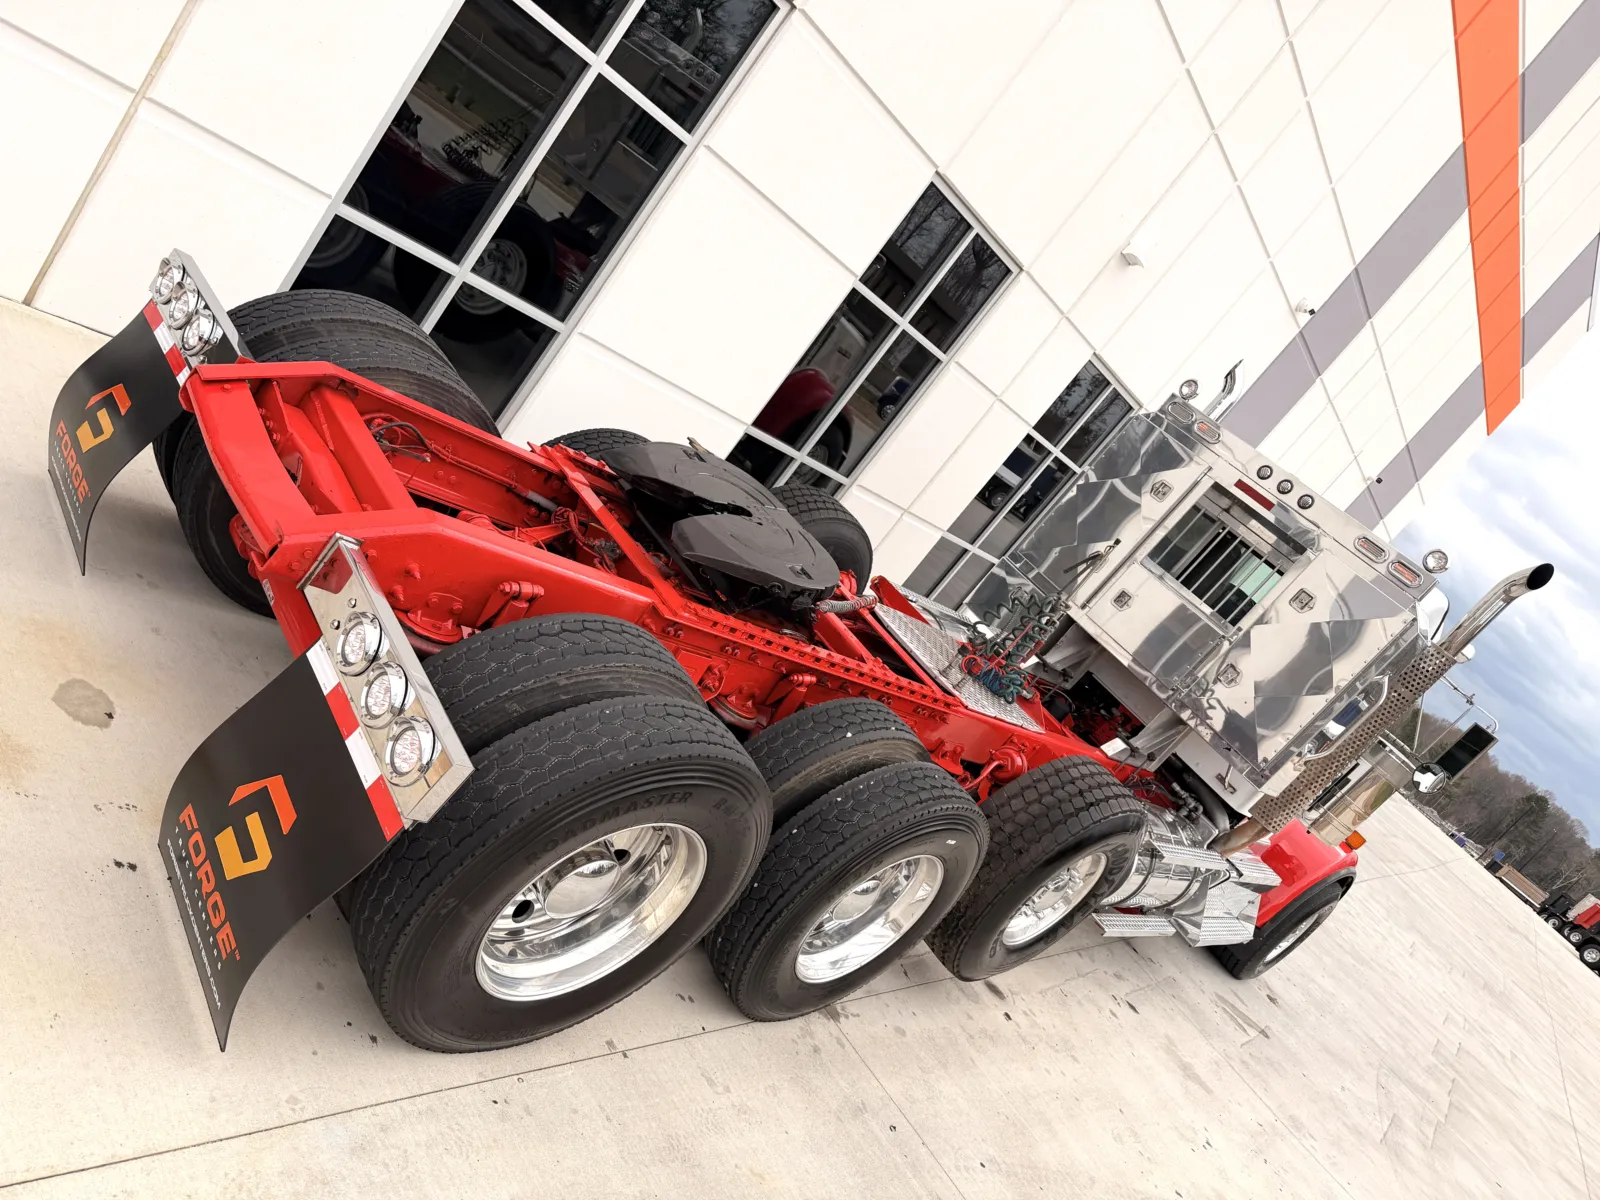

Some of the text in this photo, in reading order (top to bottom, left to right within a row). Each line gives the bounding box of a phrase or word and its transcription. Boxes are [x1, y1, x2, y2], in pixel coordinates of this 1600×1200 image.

[56, 420, 89, 504] FORGE
[175, 827, 193, 879] TRUCK
[526, 791, 693, 865] ROADMASTER
[179, 803, 237, 960] FORGE
[194, 888, 222, 970] CENTERS
